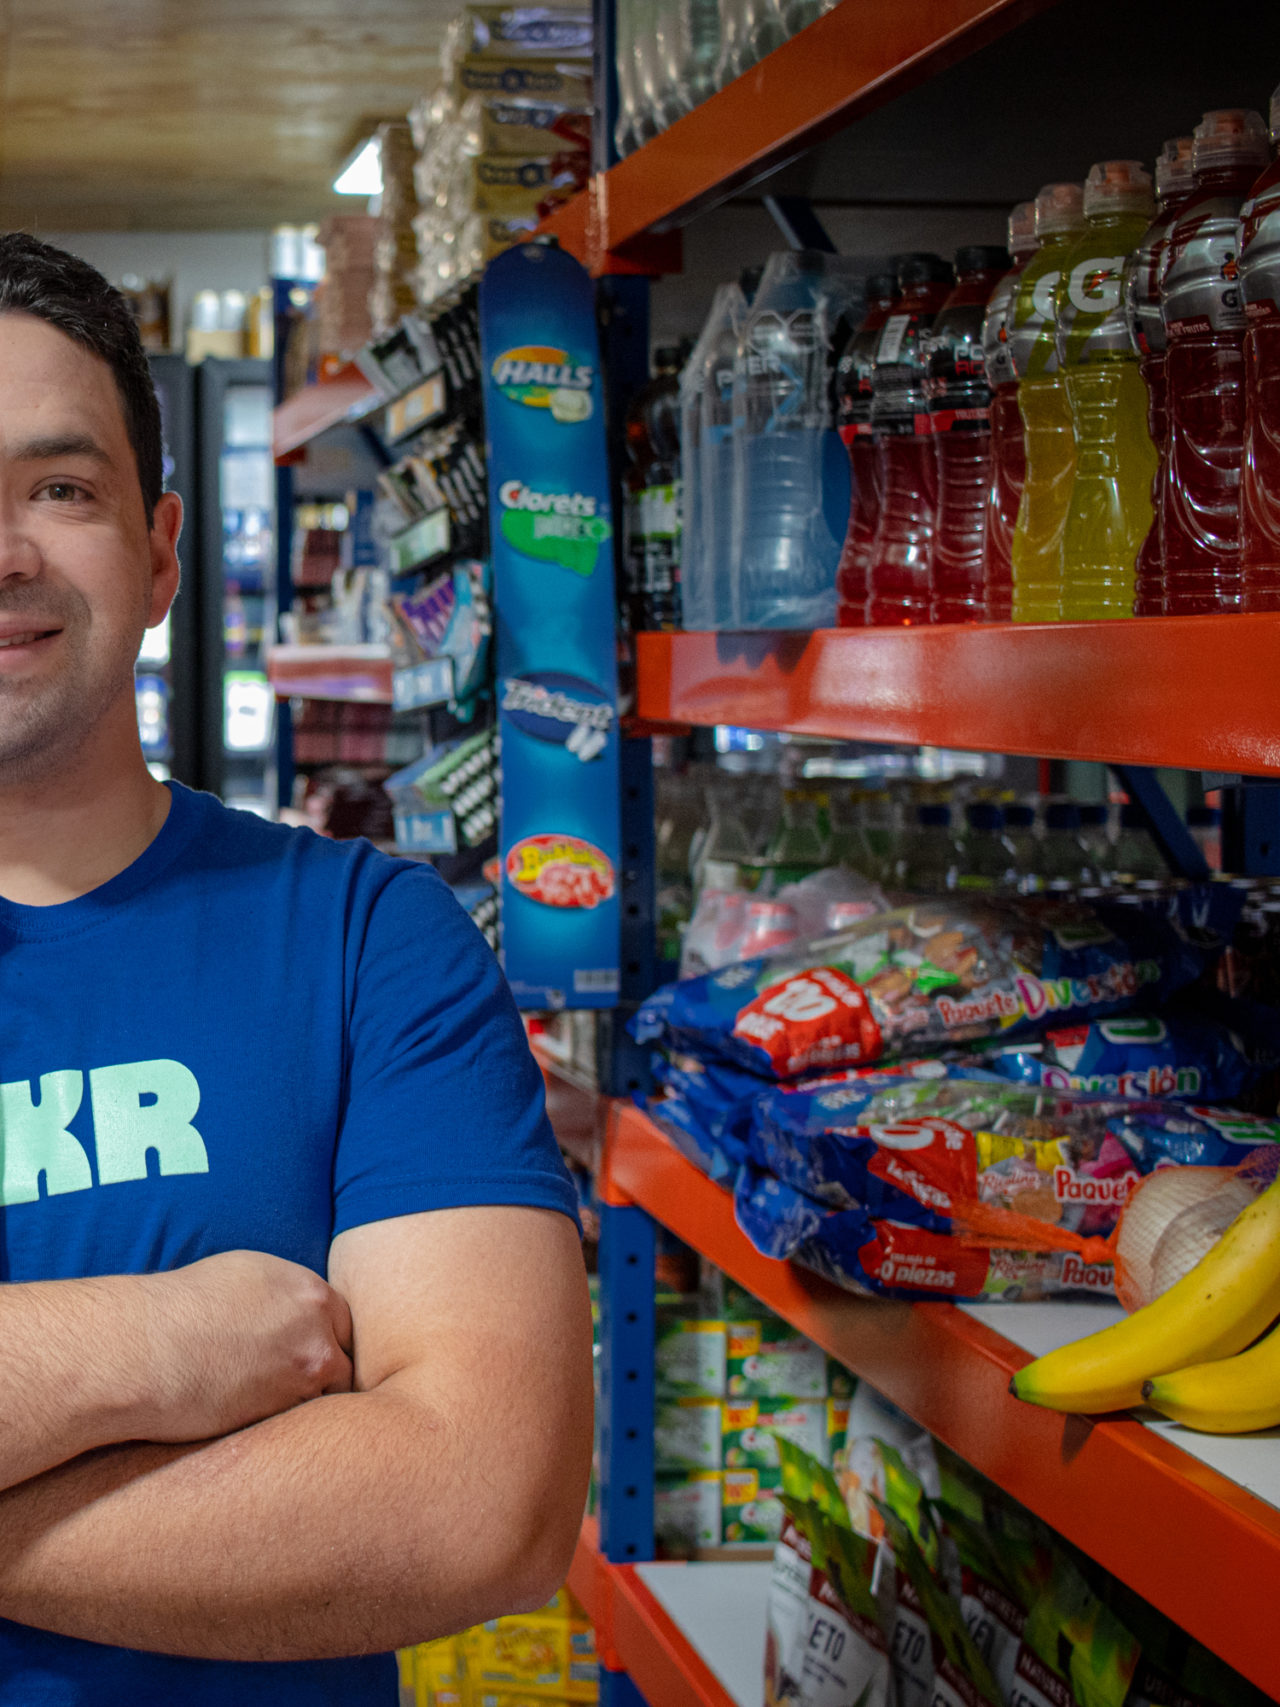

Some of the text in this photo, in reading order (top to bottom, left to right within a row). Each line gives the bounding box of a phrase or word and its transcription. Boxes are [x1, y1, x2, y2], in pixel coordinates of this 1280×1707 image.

[1068, 256, 1127, 313] G
[1221, 289, 1238, 308] G
[496, 361, 594, 388] HALLS
[499, 480, 597, 517] Clorets
[1055, 1167, 1138, 1204] Paquet
[895, 1263, 956, 1289] piezas
[1063, 1257, 1115, 1289] Paqu
[808, 1614, 846, 1663] ETO
[895, 1620, 926, 1664] ETO
